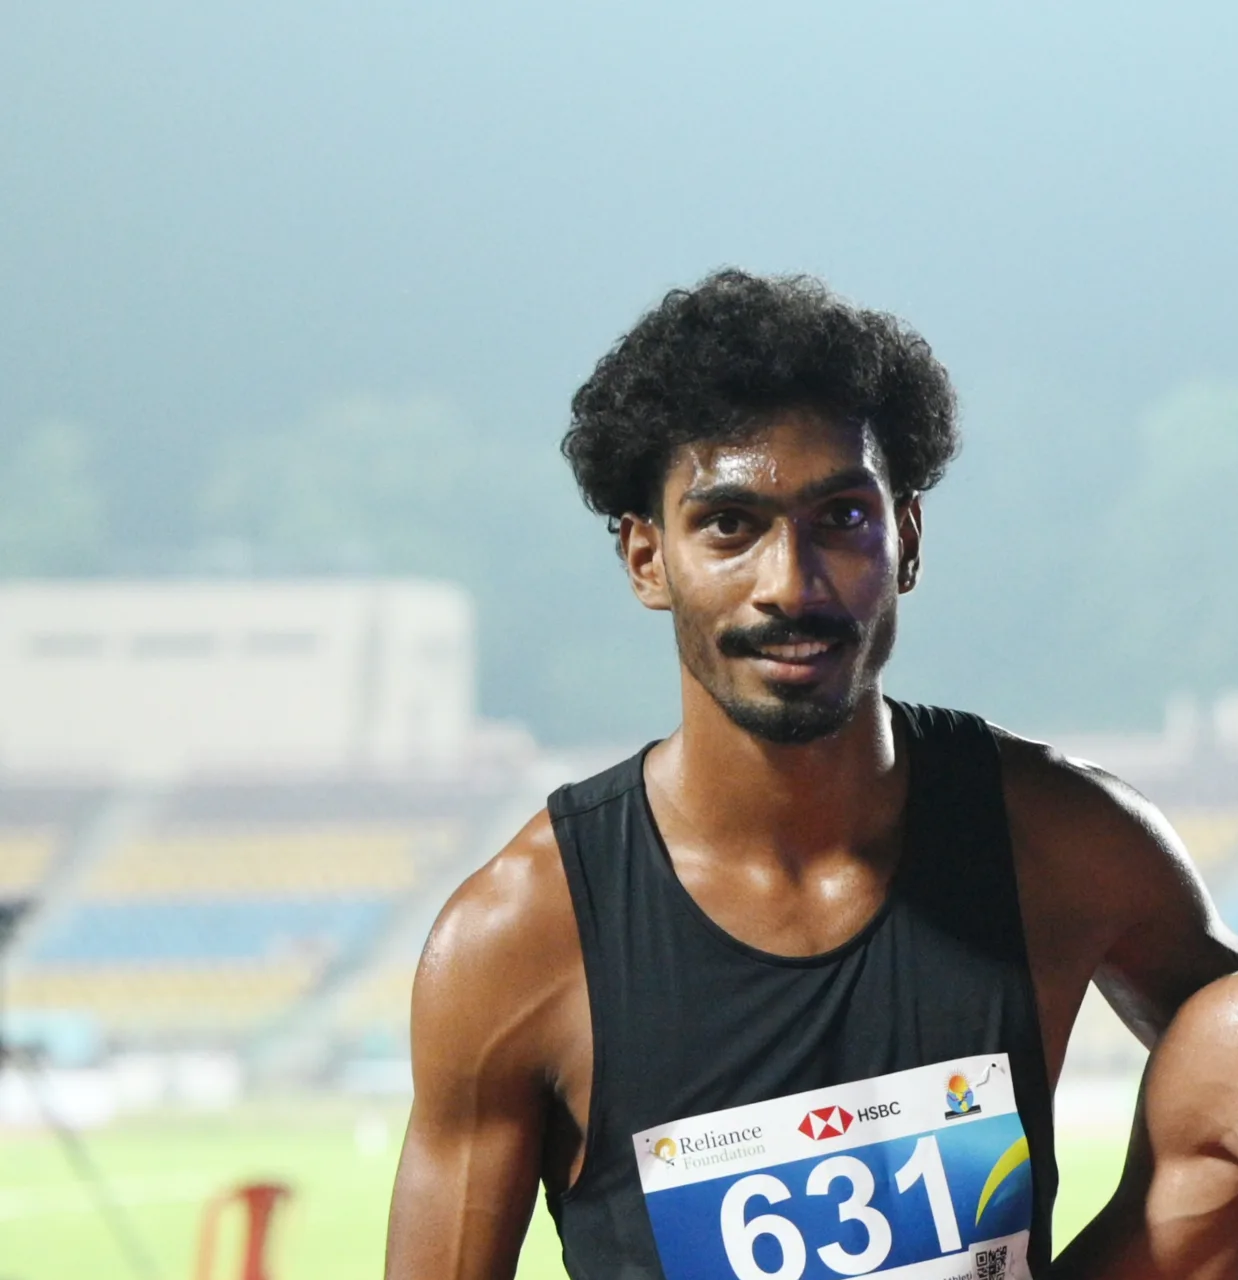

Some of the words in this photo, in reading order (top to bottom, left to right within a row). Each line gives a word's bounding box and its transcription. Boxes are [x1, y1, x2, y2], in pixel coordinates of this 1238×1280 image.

[857, 1101, 901, 1122] HSBC
[679, 1125, 762, 1154] Reliance
[683, 1143, 766, 1171] Foundation
